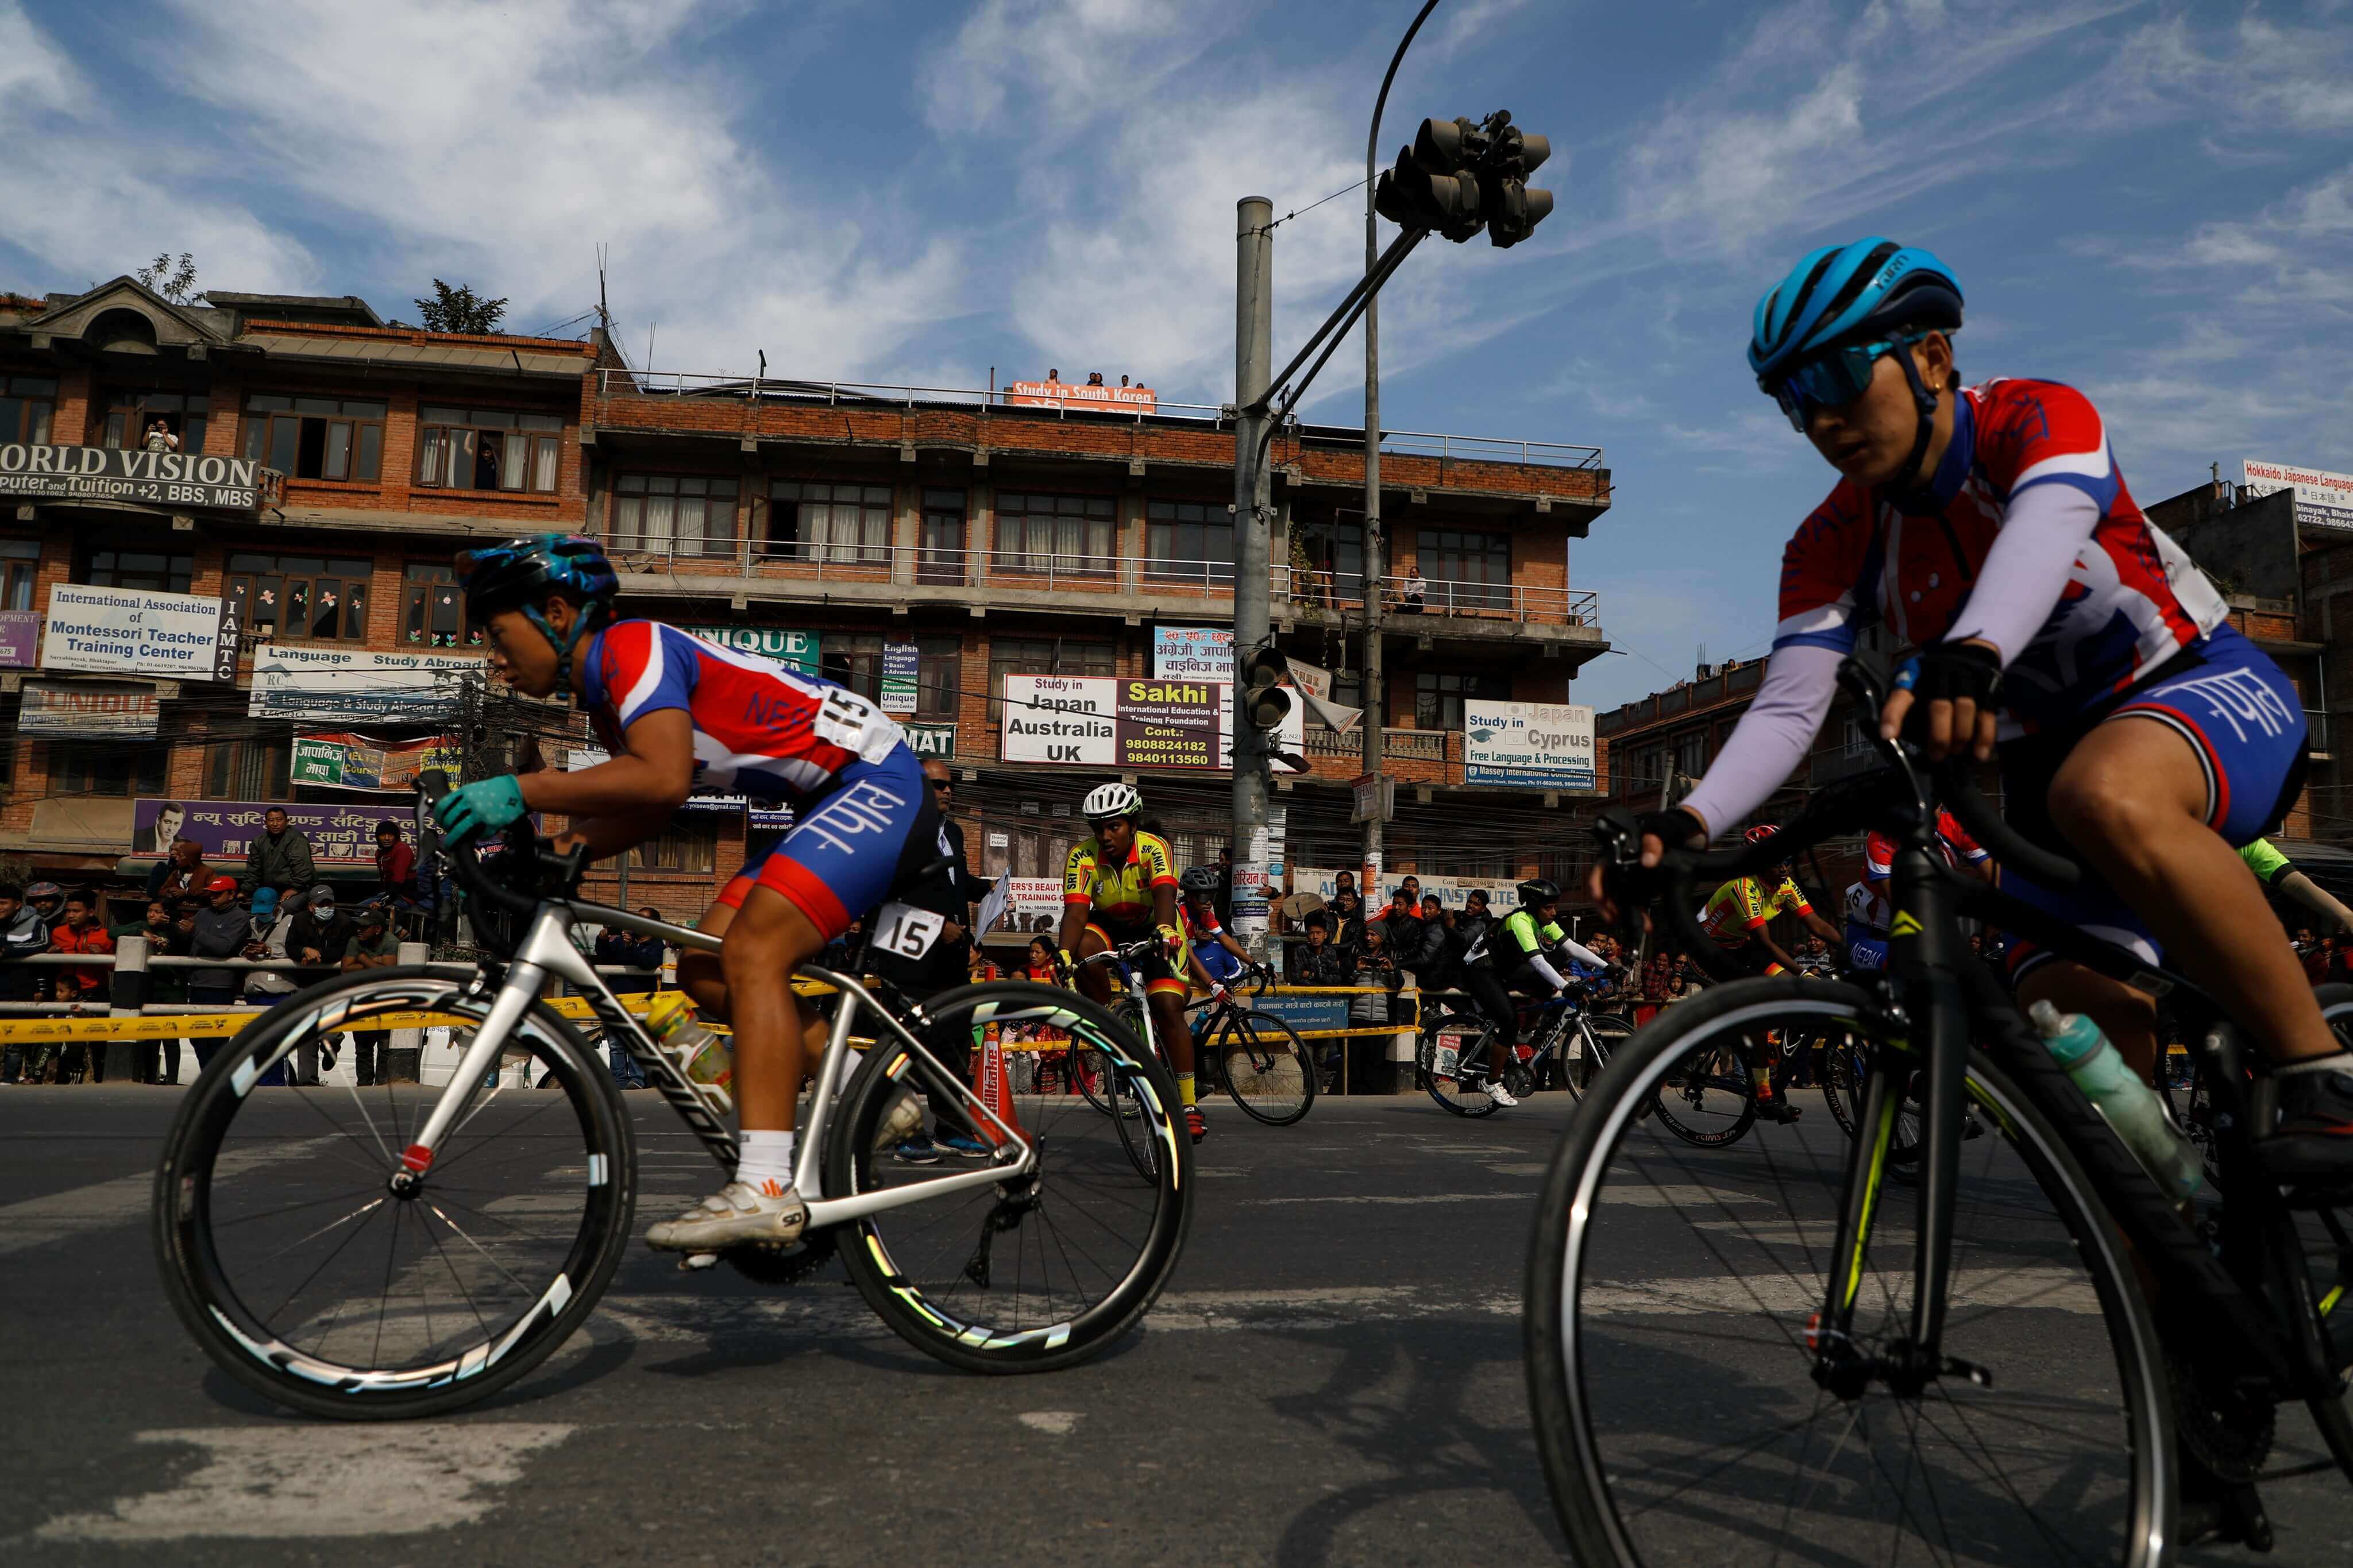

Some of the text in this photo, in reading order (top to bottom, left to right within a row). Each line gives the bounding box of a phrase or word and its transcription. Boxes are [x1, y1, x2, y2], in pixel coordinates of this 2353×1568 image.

[1016, 382, 1151, 402] Study in South Korea
[0, 443, 257, 487] ORLD VISION
[2246, 463, 2353, 493] Hokkaido Japanese Language
[48, 482, 66, 491] and
[67, 476, 134, 495] Tuition
[138, 487, 161, 502] +2,
[168, 486, 209, 506] BBS,
[214, 491, 253, 507] MBS
[2311, 491, 2336, 504] 日本語
[56, 591, 216, 615] International Association
[129, 612, 143, 623] of
[51, 620, 213, 646] Montessori Teacher
[680, 627, 808, 654] NIQUE
[67, 638, 195, 660] Training Center
[885, 644, 918, 653] English
[268, 647, 482, 669] Language Study Abroad
[1035, 678, 1082, 692] Study in
[1129, 682, 1207, 704] Sakhi
[882, 693, 915, 703] Unique
[1026, 694, 1096, 715] Japan
[1118, 705, 1168, 714] International
[1171, 707, 1210, 716] Education
[1528, 704, 1586, 725] Japan
[1008, 719, 1113, 737] Australia
[1131, 715, 1209, 725] Training Foundation
[1469, 715, 1523, 729] Study in
[1145, 727, 1184, 737] Cont.:
[1527, 729, 1590, 750] Cyprus
[1047, 745, 1082, 762] UK
[1125, 739, 1206, 751] 9808824182
[1127, 752, 1208, 764] 9840113560
[1470, 750, 1590, 768] Free Language & Processing
[1479, 766, 1505, 777] Massey
[1506, 768, 1549, 777] International
[890, 917, 929, 956] 15
